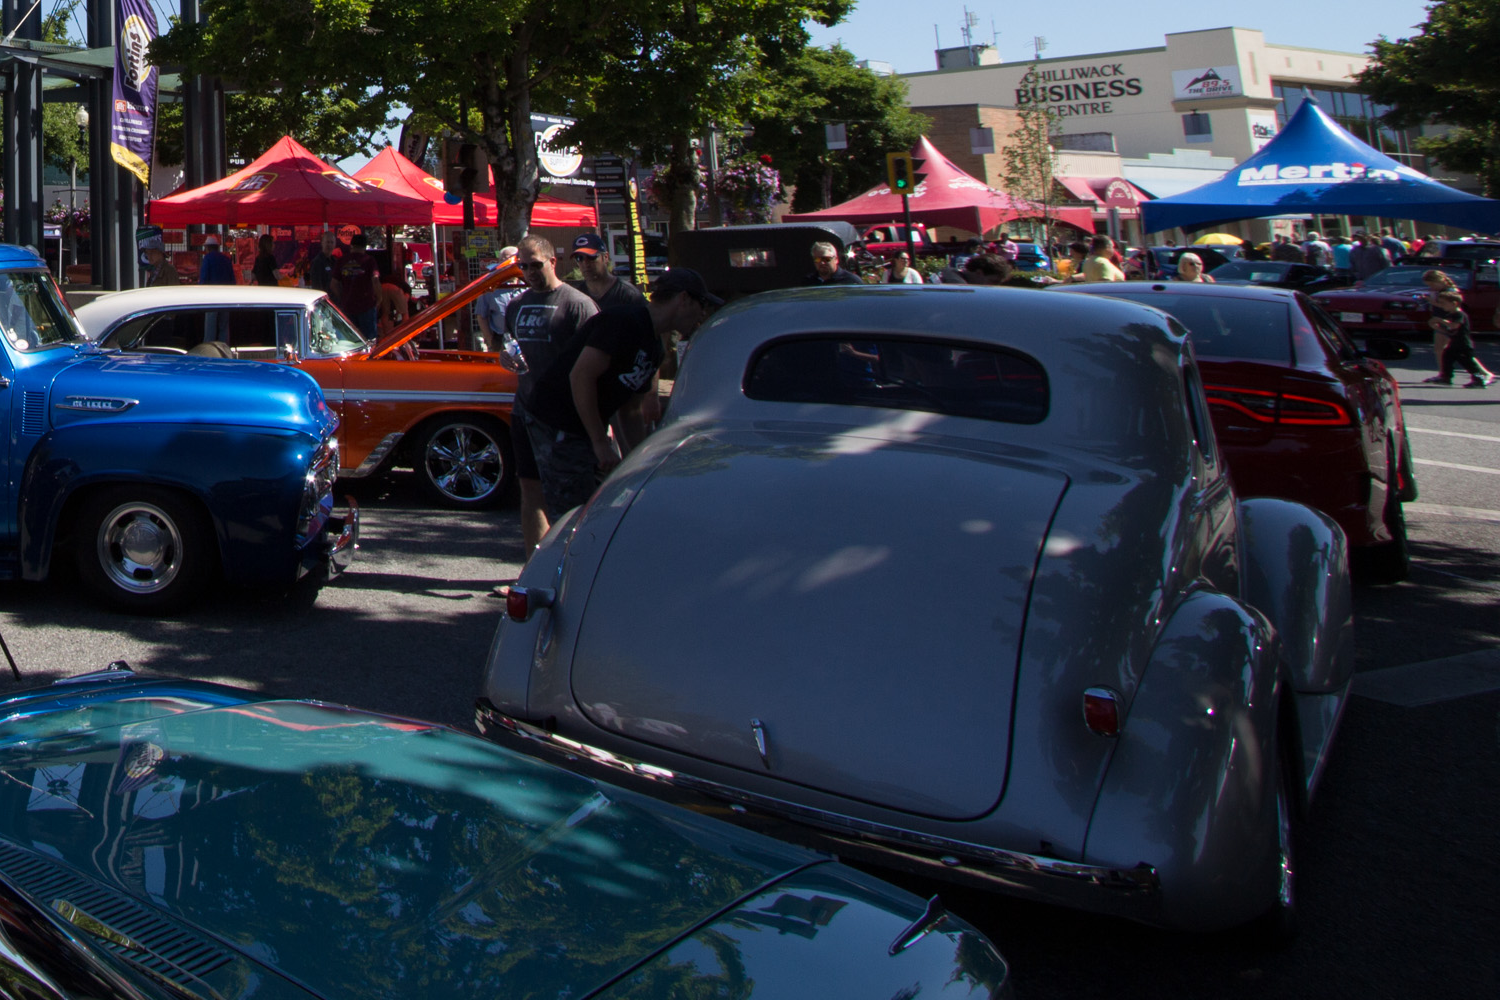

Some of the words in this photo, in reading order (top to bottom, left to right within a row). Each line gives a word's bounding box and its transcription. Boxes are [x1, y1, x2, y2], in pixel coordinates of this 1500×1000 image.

[125, 32, 142, 89] Fortins
[1022, 63, 1125, 84] CHILLIWACK
[1014, 78, 1144, 105] BUSINESS
[1046, 101, 1114, 117] CENTRE
[1239, 162, 1399, 181] Mertin
